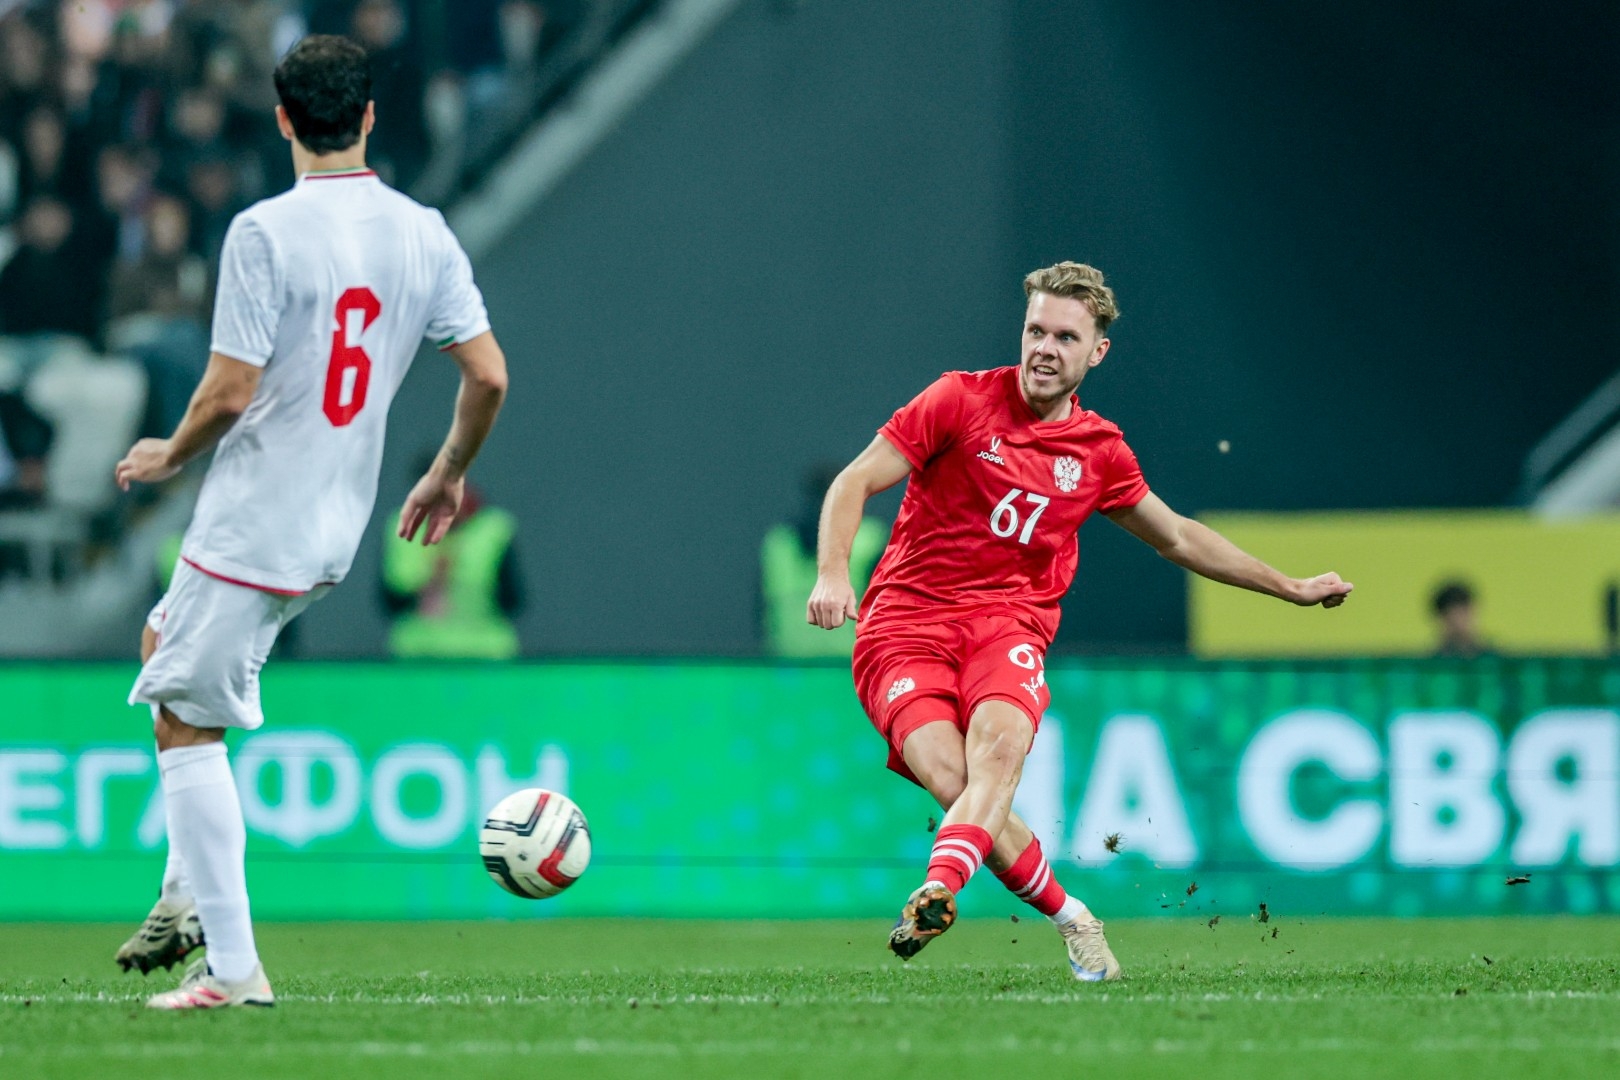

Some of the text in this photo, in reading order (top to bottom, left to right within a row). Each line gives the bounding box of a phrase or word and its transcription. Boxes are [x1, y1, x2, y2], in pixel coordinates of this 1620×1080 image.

[322, 286, 382, 428] 6
[990, 488, 1050, 545] 67
[1238, 708, 1618, 869] СВЯ
